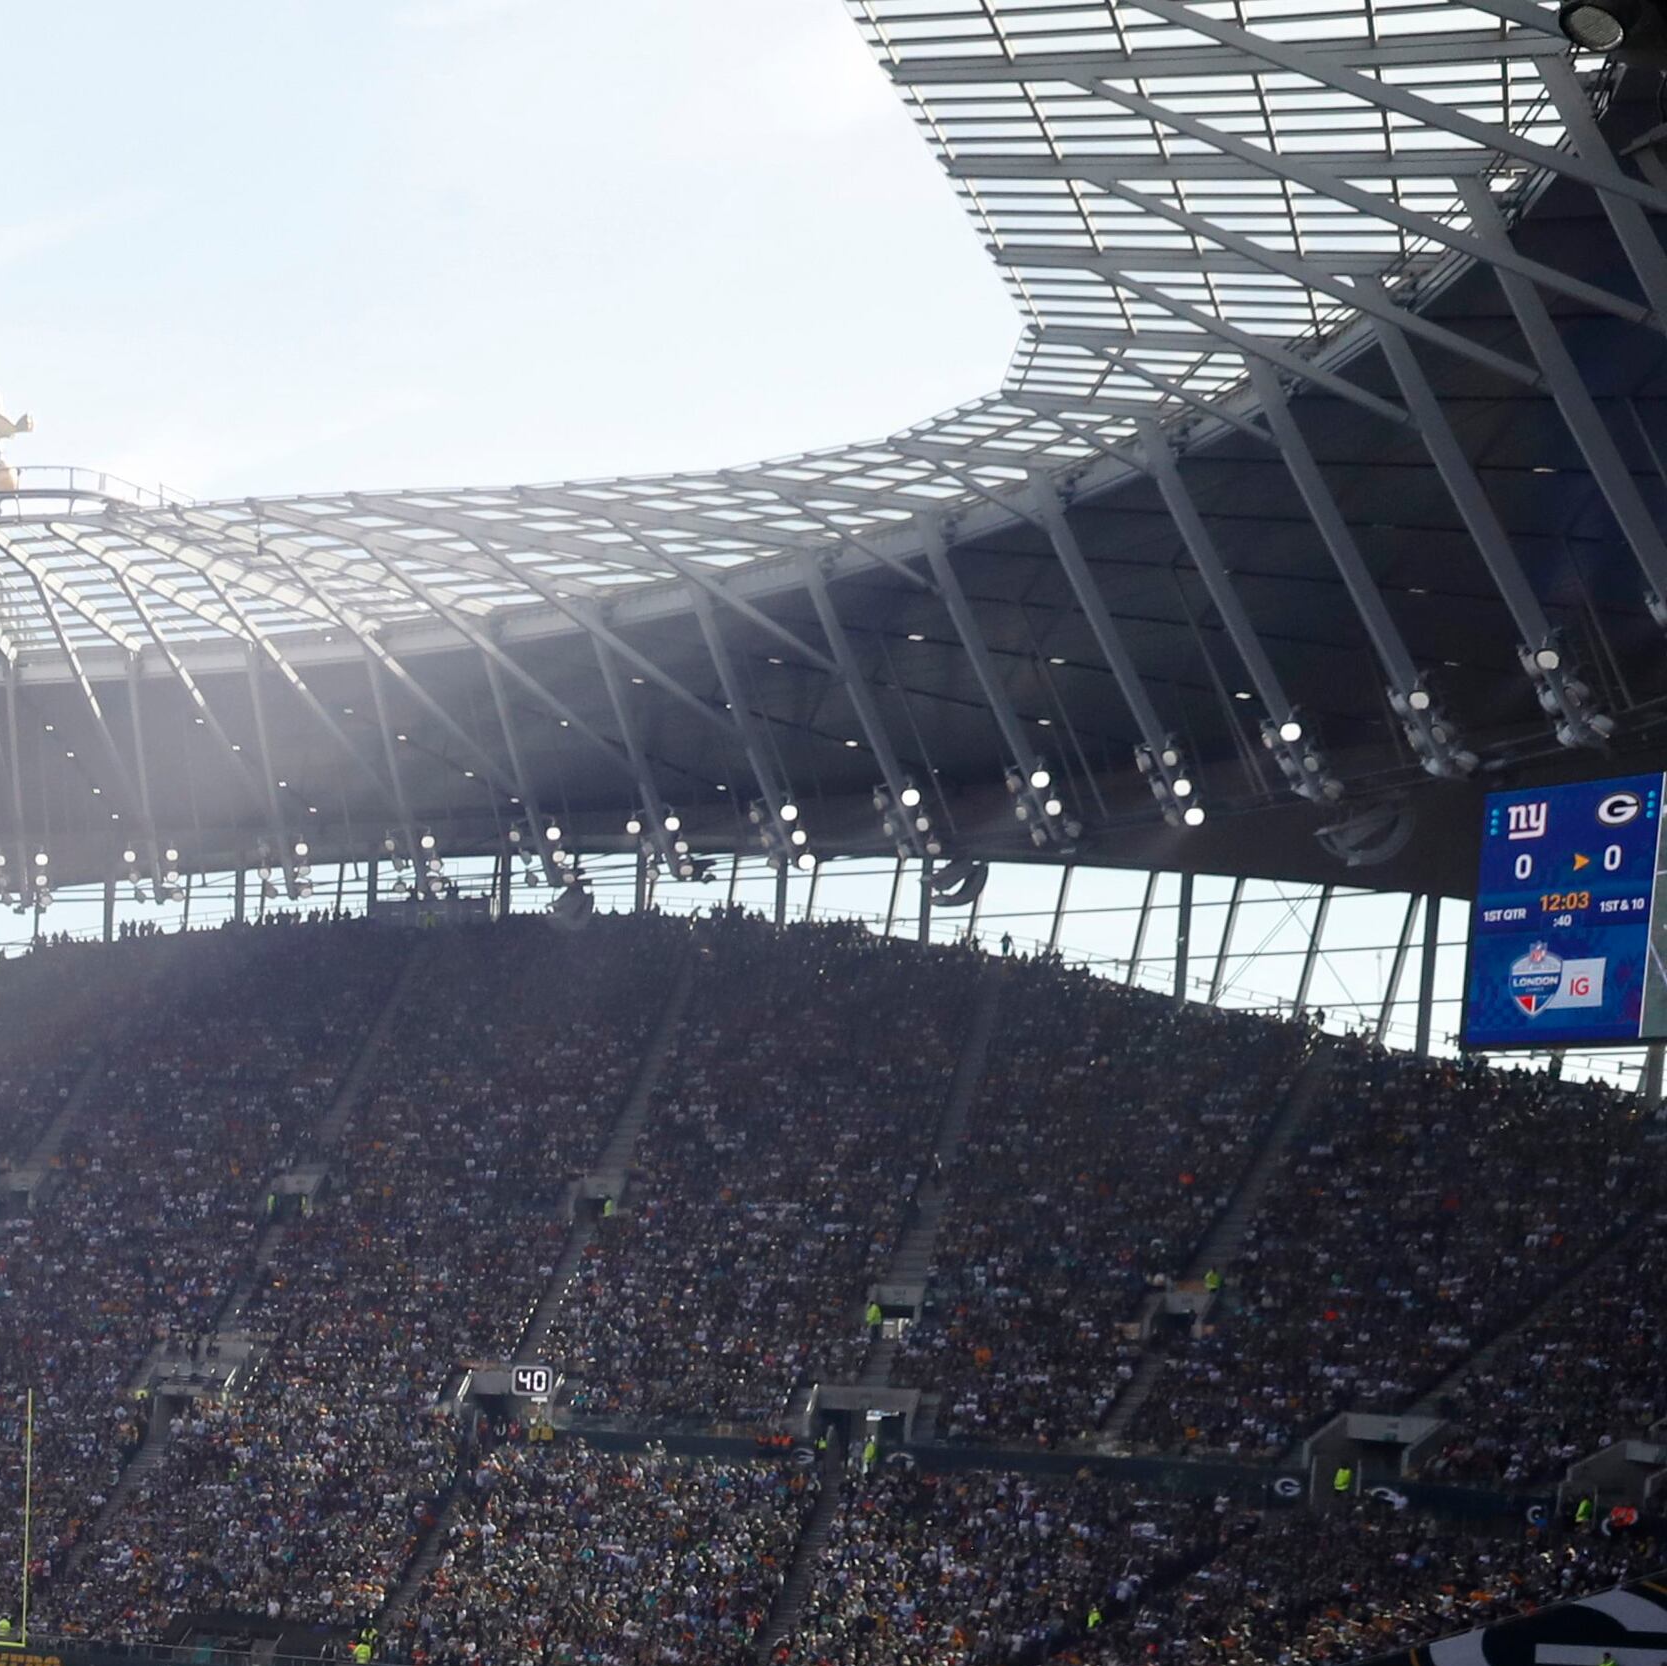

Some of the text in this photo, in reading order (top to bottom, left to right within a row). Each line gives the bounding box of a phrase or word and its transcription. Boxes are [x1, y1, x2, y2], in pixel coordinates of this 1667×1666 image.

[1515, 853, 1532, 880] 0
[1603, 844, 1622, 871] 0
[1540, 891, 1590, 912] 12:03
[1600, 898, 1644, 912] 1ST 10
[1483, 910, 1503, 922] 1ST
[1512, 975, 1559, 987] LONDON
[1570, 978, 1589, 996] IG
[518, 1369, 547, 1393] 40
